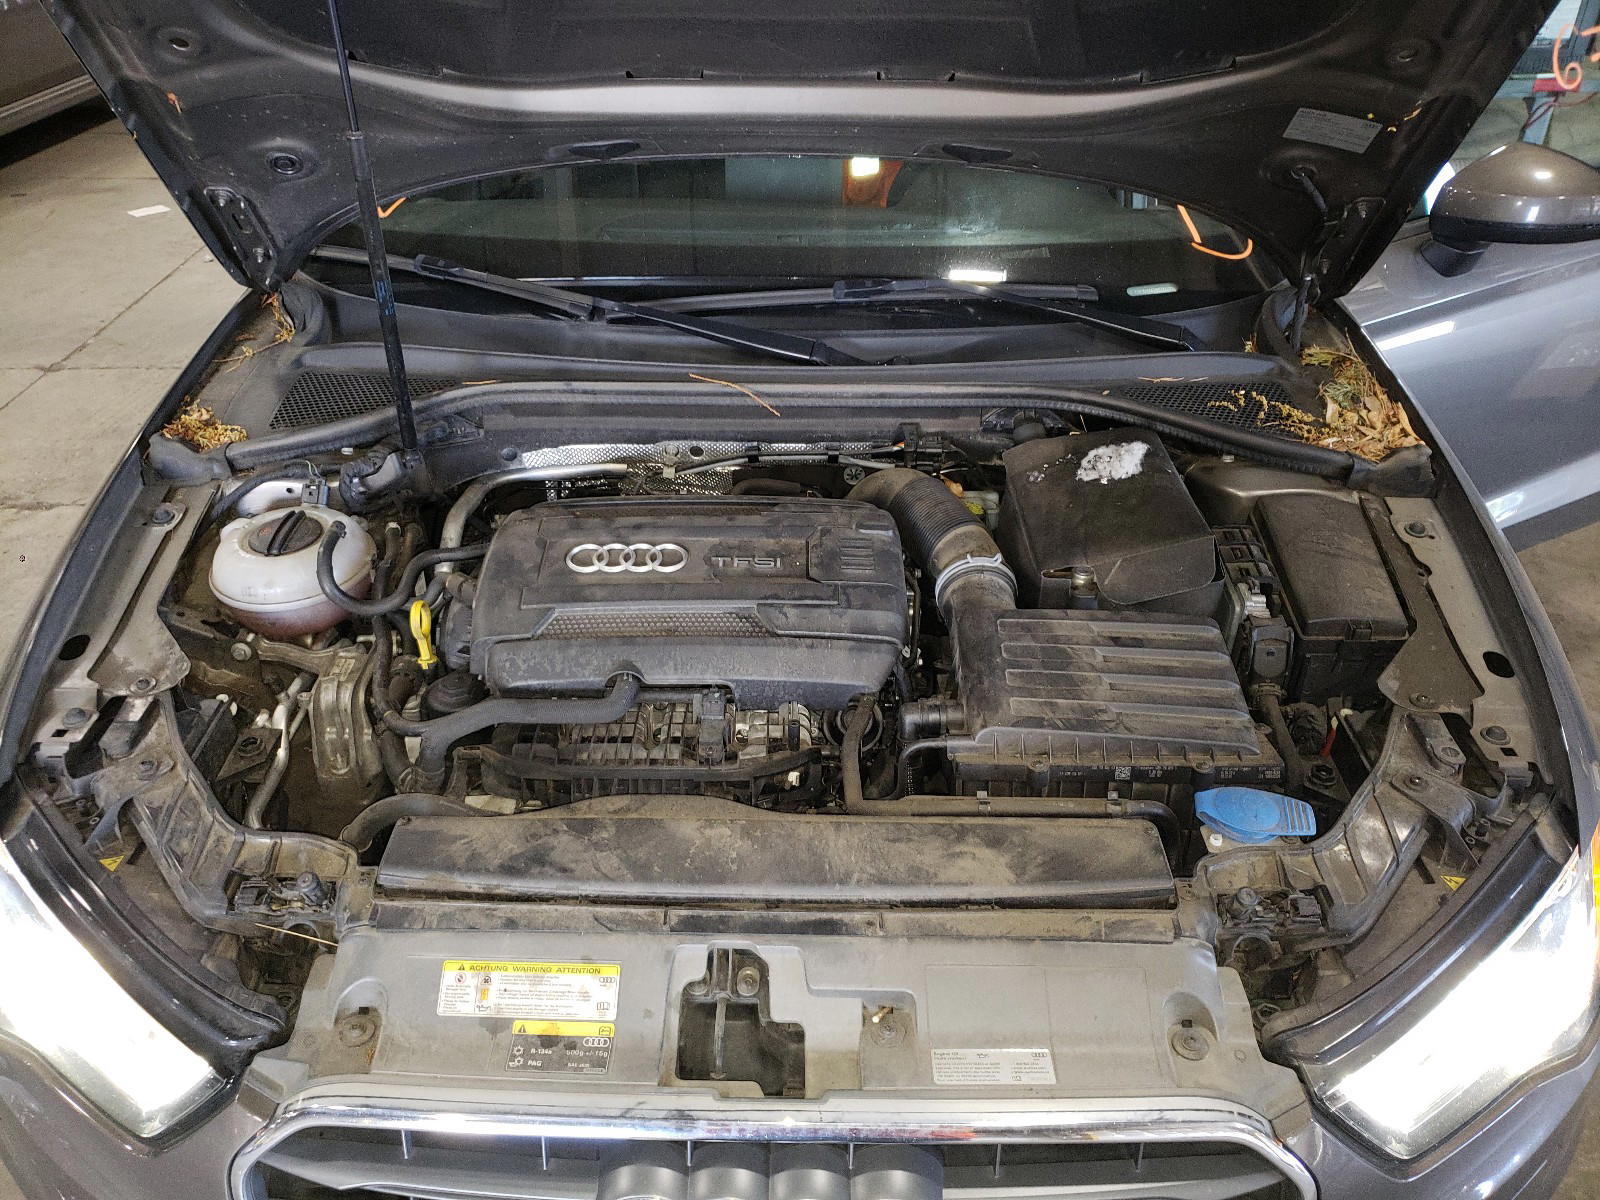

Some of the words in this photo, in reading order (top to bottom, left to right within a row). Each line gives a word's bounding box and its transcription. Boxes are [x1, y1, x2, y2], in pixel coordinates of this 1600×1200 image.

[711, 557, 781, 569] TFSI
[469, 964, 509, 972] ACHTUNG
[512, 965, 553, 974] WARNING
[555, 967, 601, 975] ATTENTION
